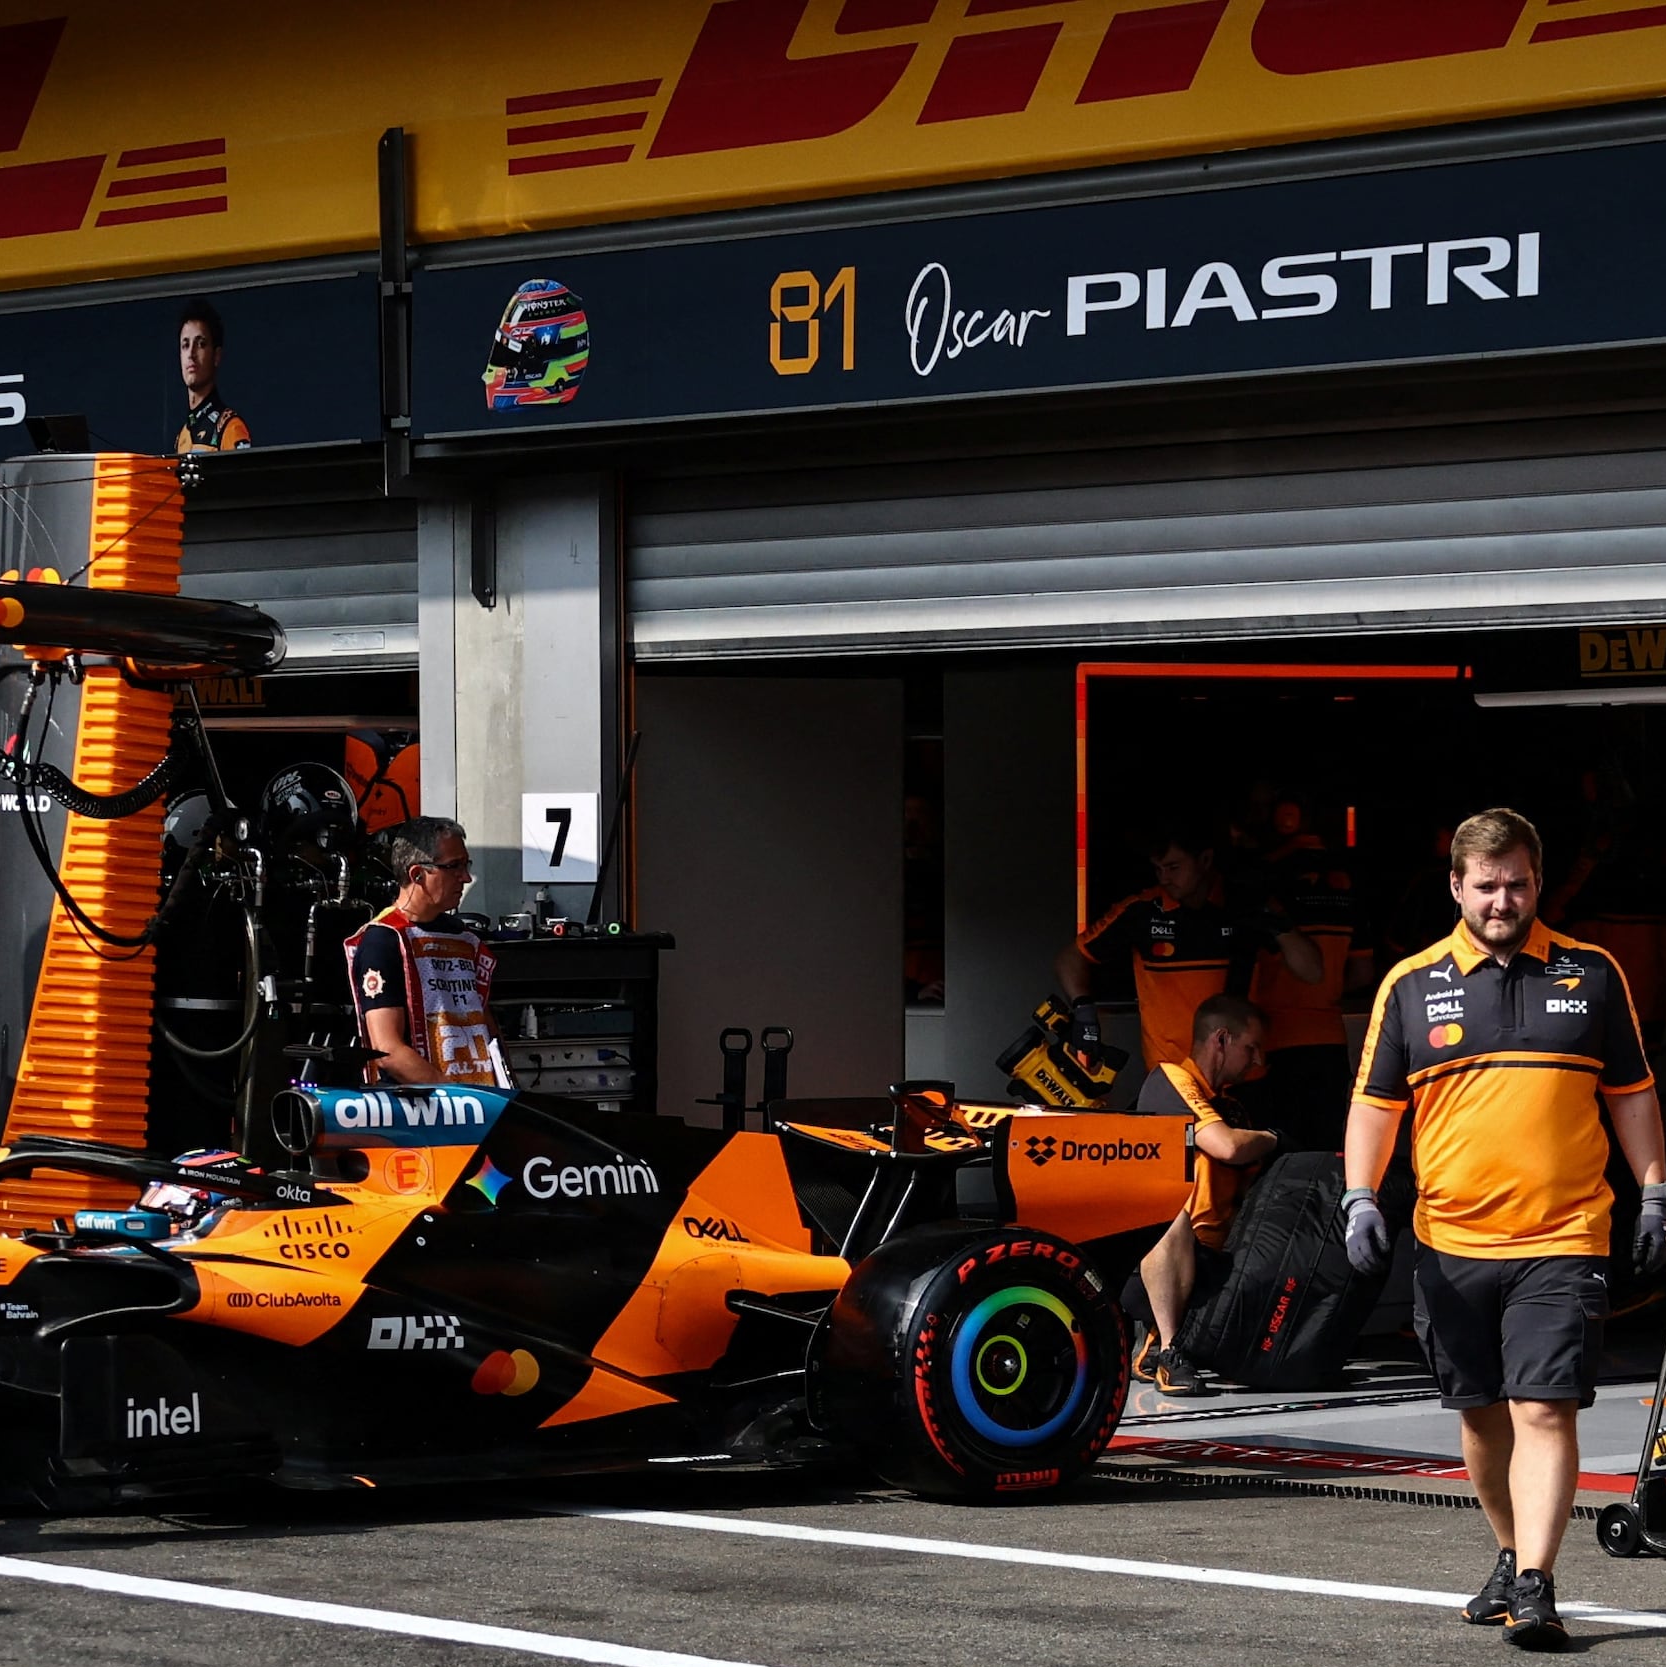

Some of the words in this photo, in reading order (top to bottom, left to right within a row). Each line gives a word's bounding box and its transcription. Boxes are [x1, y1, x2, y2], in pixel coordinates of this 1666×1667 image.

[768, 266, 856, 375] 81
[906, 263, 1050, 376] Oscar
[1066, 232, 1540, 337] PIASTRI
[545, 807, 572, 867] 7
[1427, 1001, 1463, 1016] DELL
[1546, 1000, 1587, 1014] OKX
[335, 1091, 392, 1128] all
[397, 1089, 484, 1126] win
[1062, 1139, 1162, 1166] Dropbox
[187, 1170, 205, 1180] IRON
[205, 1172, 241, 1185] MOUNTAIN
[395, 1155, 417, 1188] E
[523, 1154, 660, 1200] Gemini
[276, 1185, 311, 1203] okta
[77, 1216, 94, 1230] all
[95, 1216, 116, 1230] win
[683, 1217, 751, 1243] DELL
[279, 1243, 350, 1259] CISCO
[958, 1257, 977, 1285] P
[986, 1241, 1081, 1269] ZERO
[6, 1303, 29, 1311] Team
[255, 1292, 341, 1308] ClubAvolta
[6, 1311, 39, 1319] Bahrain
[1269, 1296, 1291, 1335] OSCAR
[127, 1392, 200, 1439] intel
